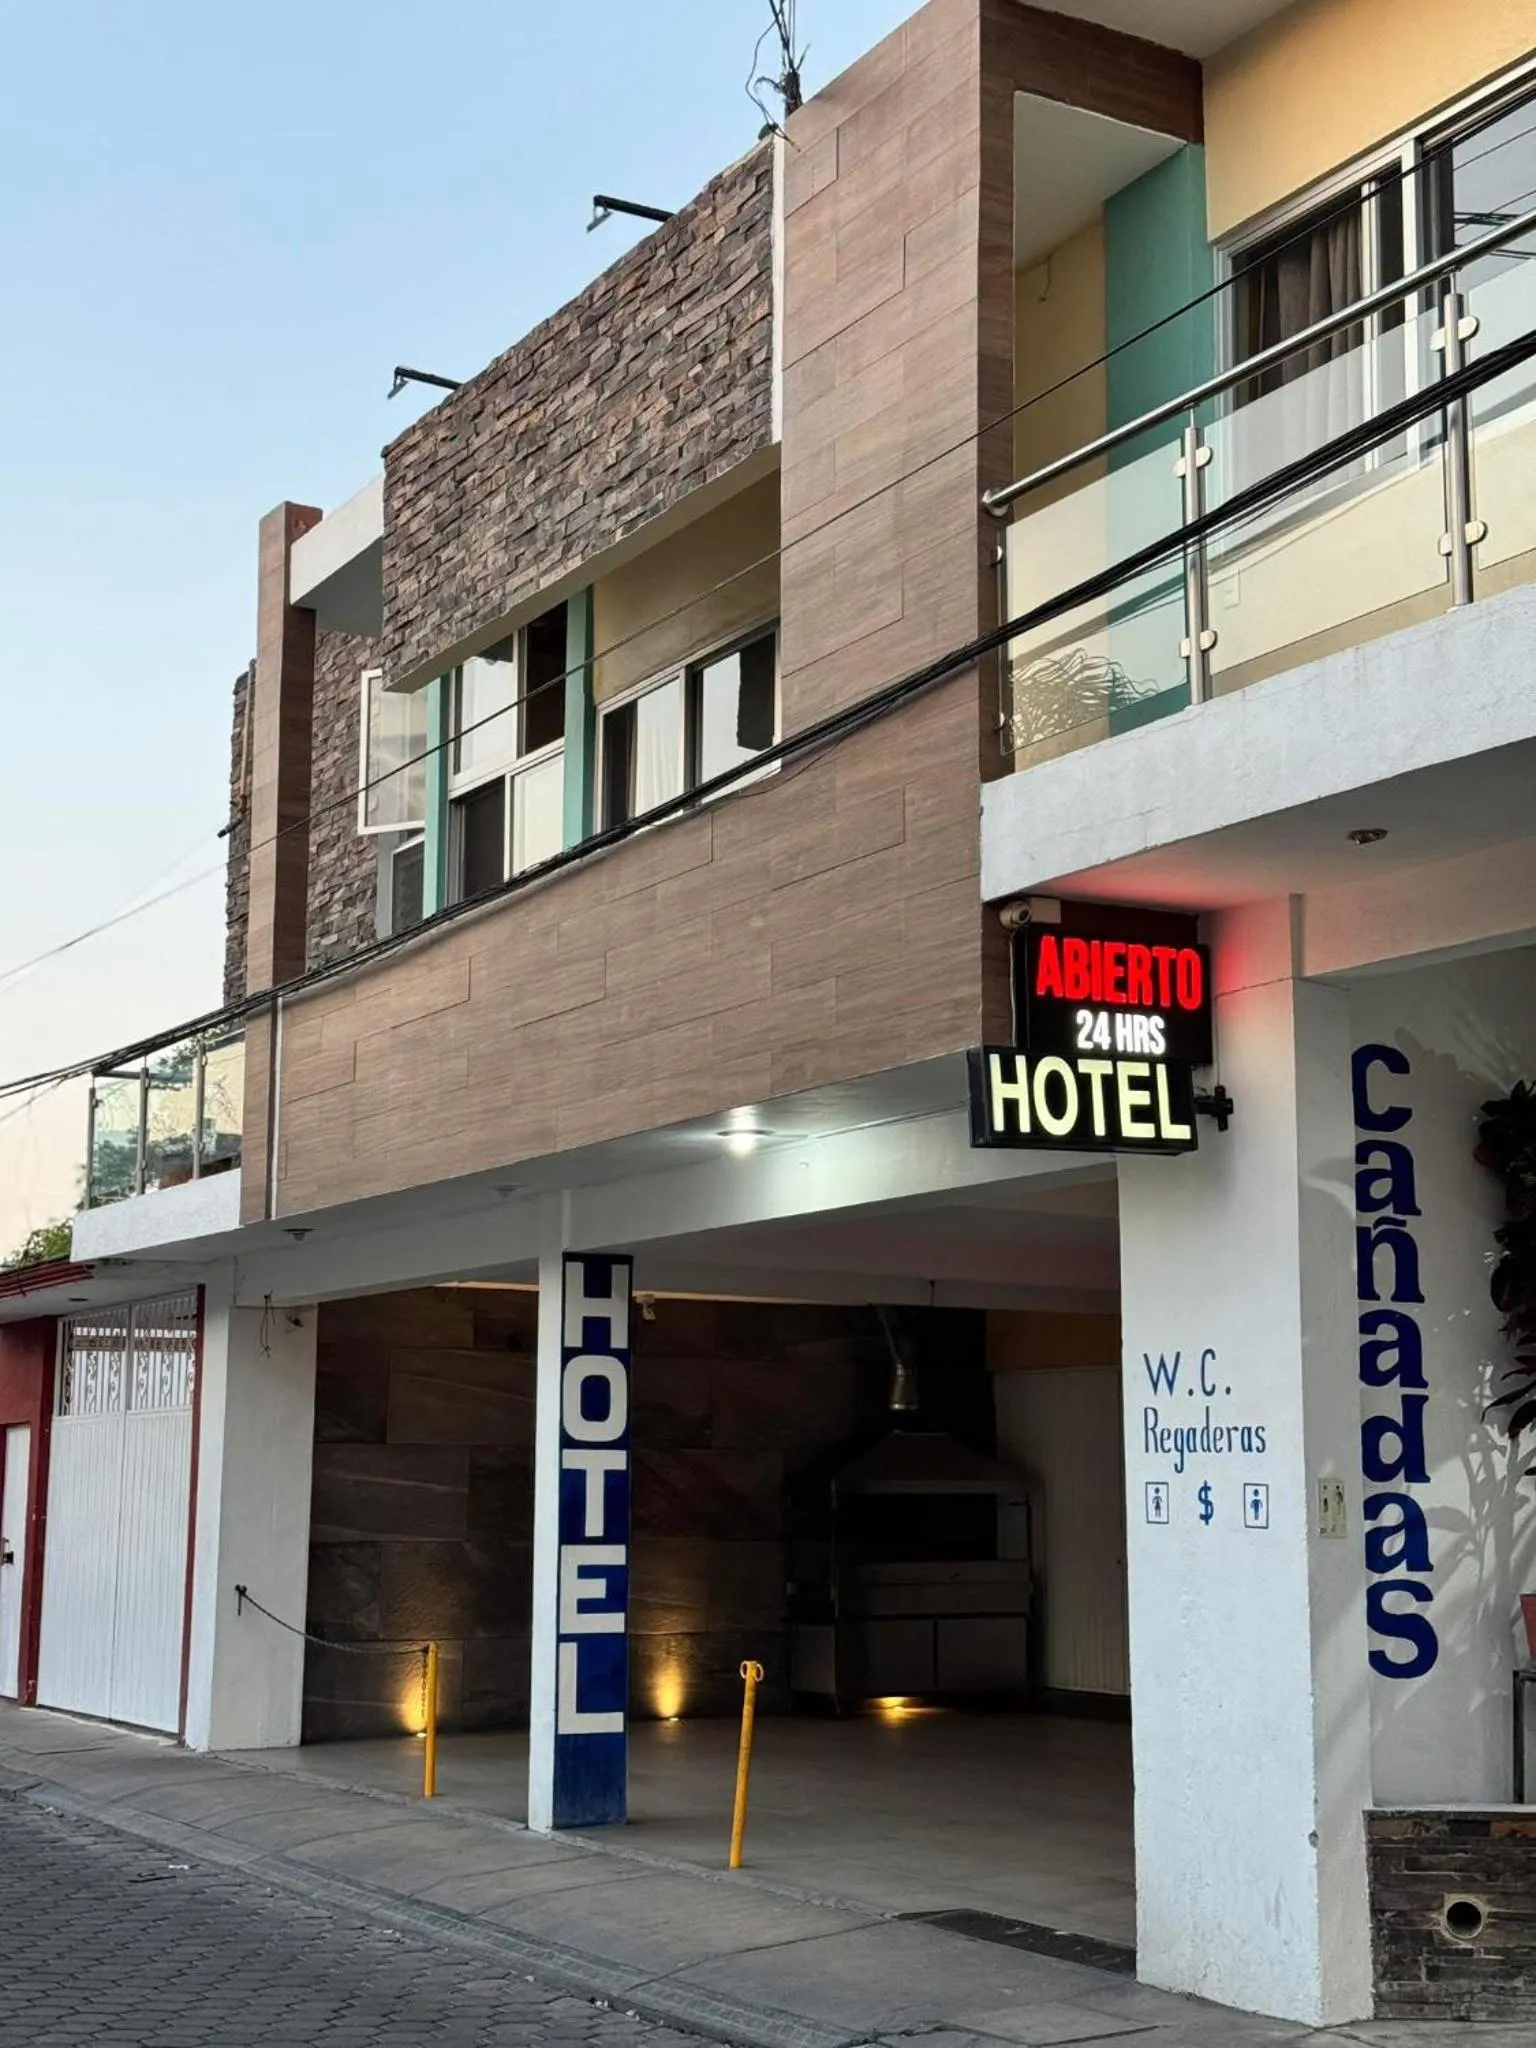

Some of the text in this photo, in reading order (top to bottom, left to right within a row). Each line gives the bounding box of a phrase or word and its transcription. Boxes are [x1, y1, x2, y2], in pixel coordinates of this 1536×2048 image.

[1036, 935, 1203, 1011] ABIERTO
[1076, 1009, 1167, 1055] 24 HRS
[989, 1053, 1192, 1140] HOTEL
[1143, 1348, 1232, 1397] W.C.
[1143, 1405, 1267, 1474] Regaderas
[557, 1261, 630, 1735] HOTEL
